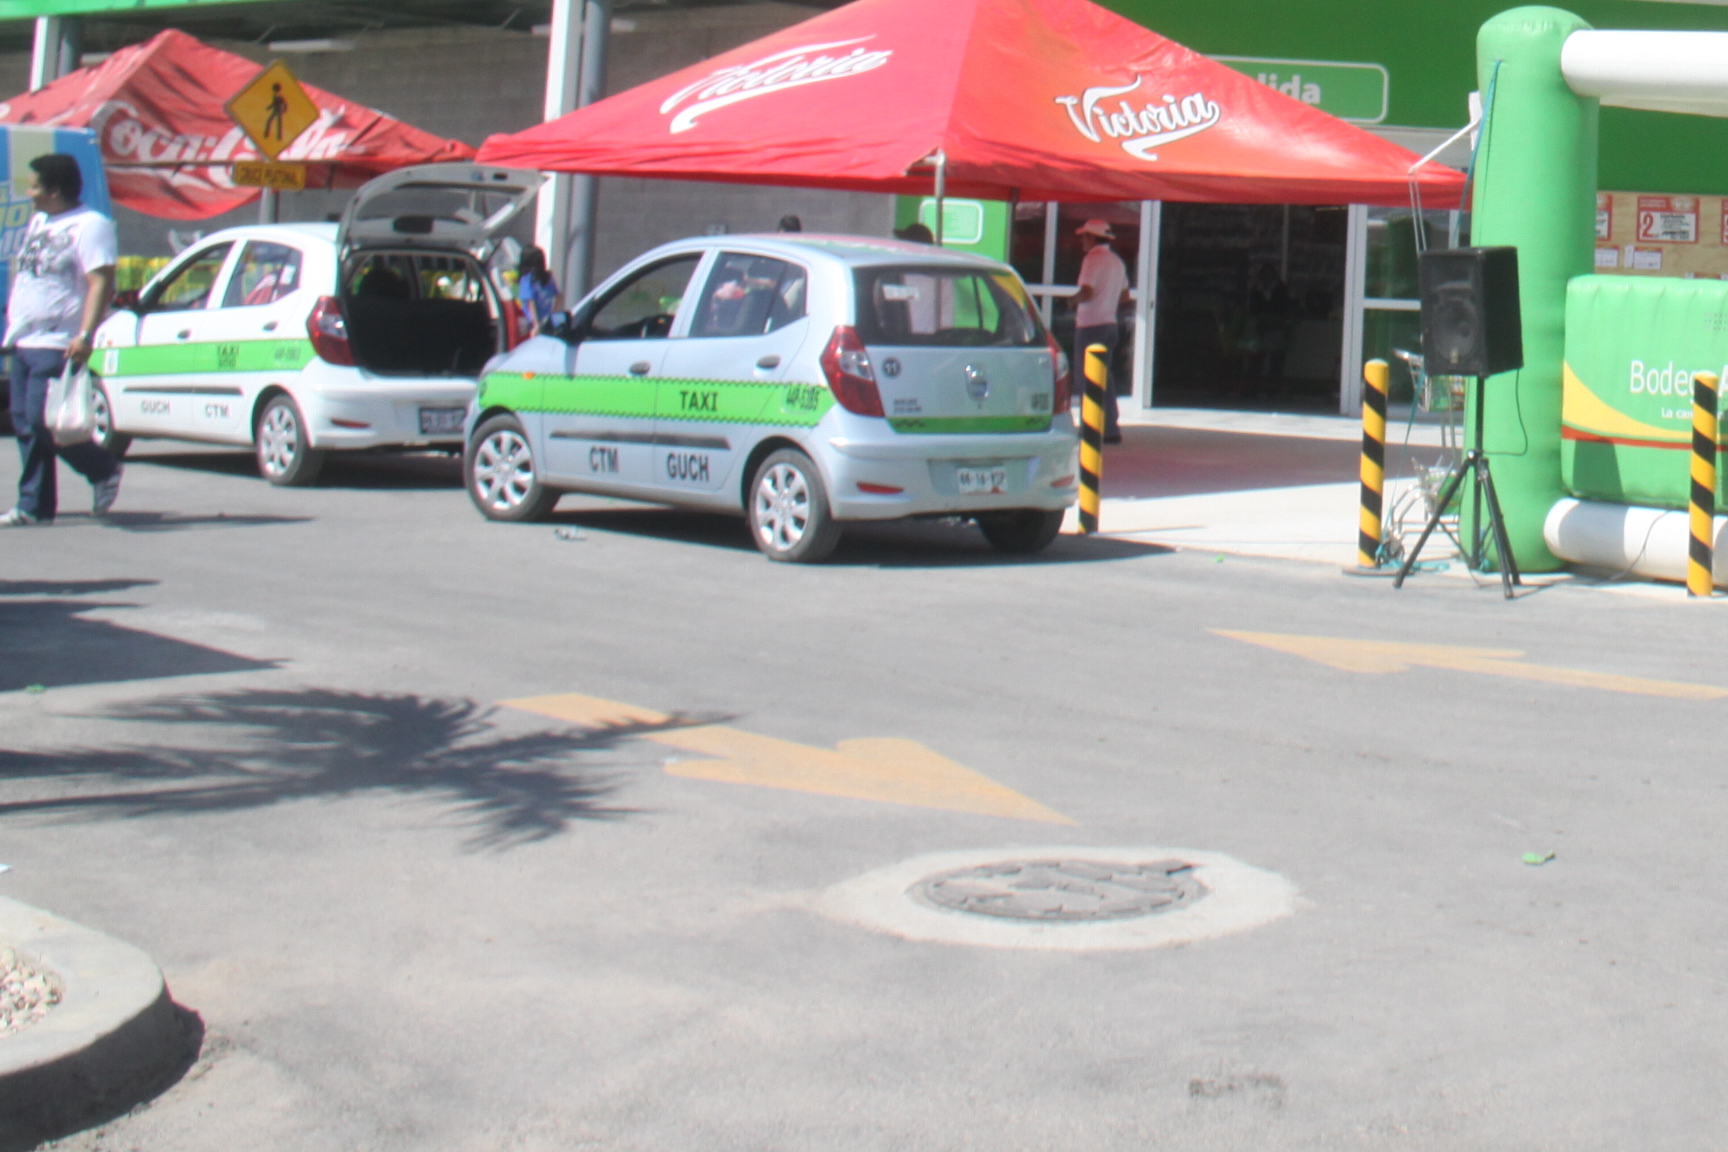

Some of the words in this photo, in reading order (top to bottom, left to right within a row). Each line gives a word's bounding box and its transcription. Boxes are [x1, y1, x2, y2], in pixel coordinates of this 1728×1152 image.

[1055, 74, 1221, 161] Victoria
[204, 401, 230, 418] CTM
[679, 390, 719, 413] TAXI
[588, 446, 619, 473] CTM
[666, 452, 710, 482] GUCH
